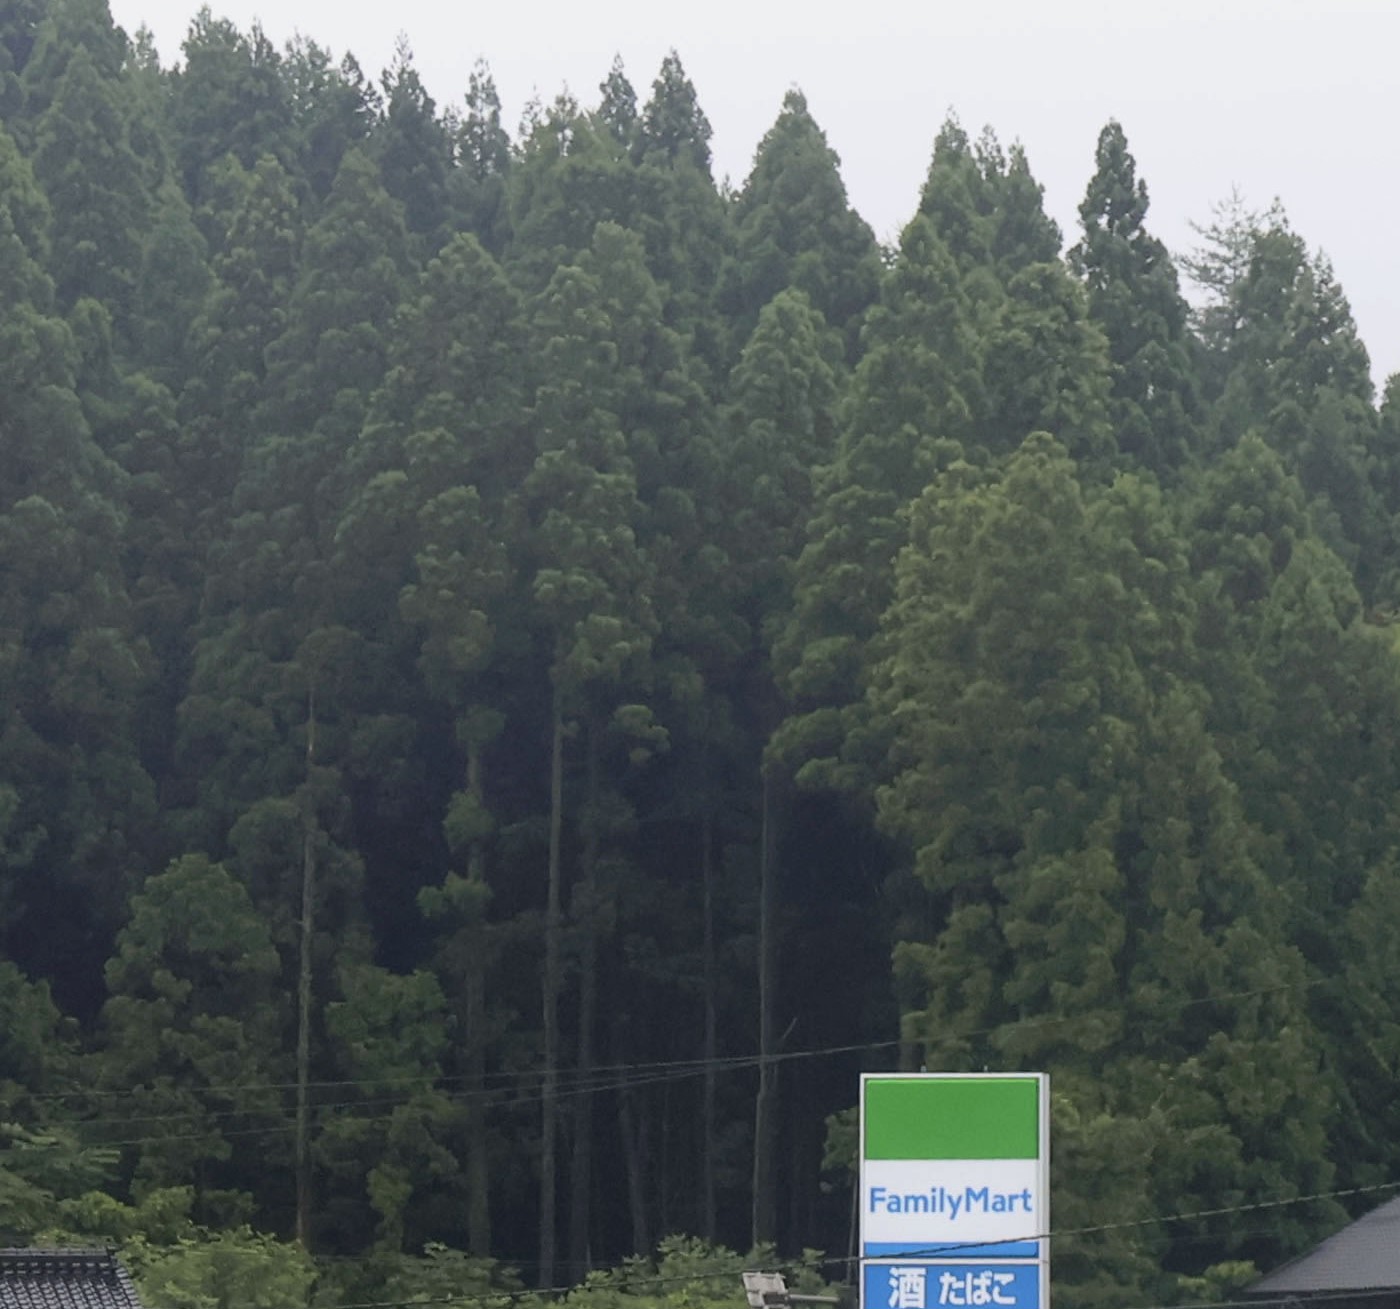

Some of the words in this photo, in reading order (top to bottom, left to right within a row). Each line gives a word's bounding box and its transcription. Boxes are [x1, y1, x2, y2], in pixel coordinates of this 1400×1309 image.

[870, 1186, 1033, 1220] FamilyMart
[888, 1267, 927, 1309] 酒
[939, 1271, 1016, 1305] たばこ
